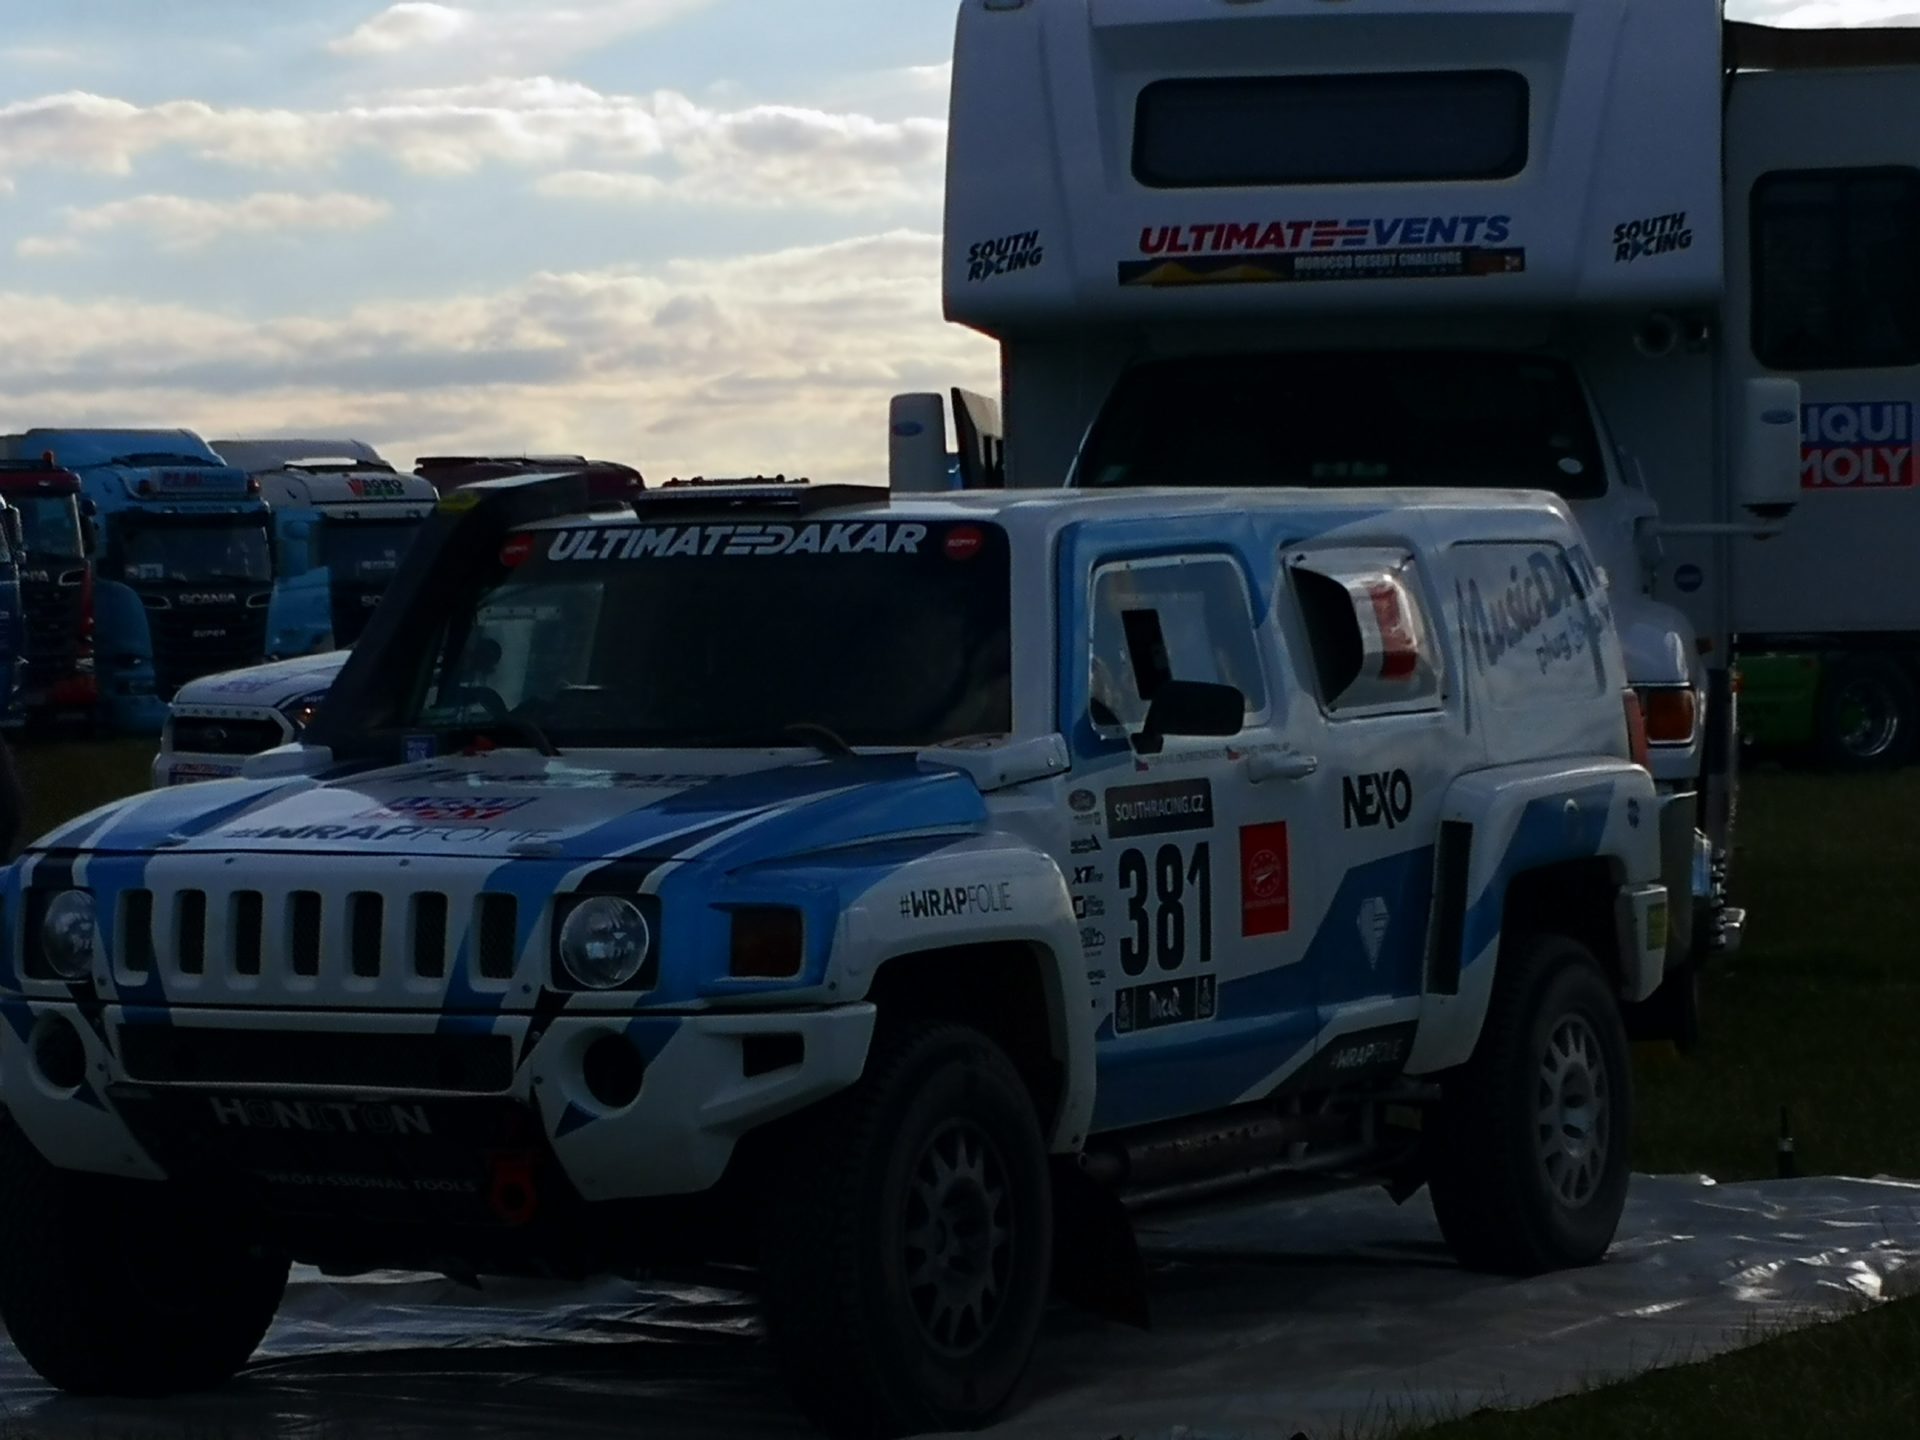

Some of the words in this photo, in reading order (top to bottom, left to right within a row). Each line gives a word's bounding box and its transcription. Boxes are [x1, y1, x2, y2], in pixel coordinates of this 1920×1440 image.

[1613, 212, 1687, 244] SOUTH
[966, 230, 1039, 262] SOUTH
[1354, 253, 1397, 269] DESERT
[1398, 251, 1463, 267] CHALLENGE
[1801, 404, 1907, 443] IQUI
[1114, 794, 1206, 822] SOUTHRACING.CZ
[1343, 769, 1412, 829] NEXO
[900, 882, 1013, 920] #WRAPFOLIE
[1118, 841, 1212, 976] 381
